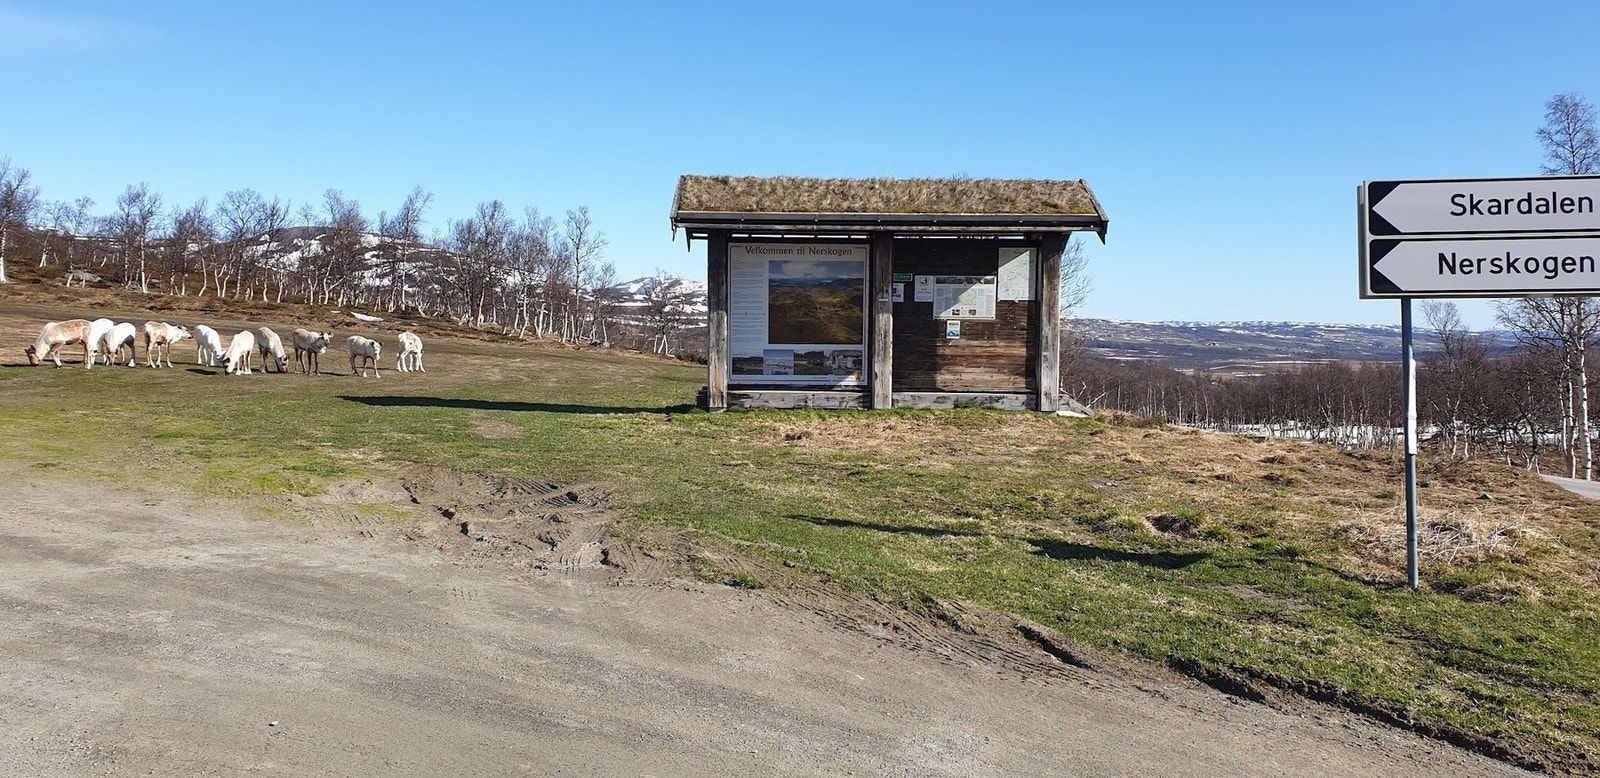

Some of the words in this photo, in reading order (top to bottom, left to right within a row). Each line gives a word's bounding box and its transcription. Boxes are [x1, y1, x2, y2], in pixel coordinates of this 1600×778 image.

[1450, 191, 1594, 217] Skardalen
[745, 246, 794, 255] Velkommen
[797, 246, 805, 255] til
[808, 246, 852, 257] Nerskogen
[1438, 251, 1595, 279] Nerskogen
